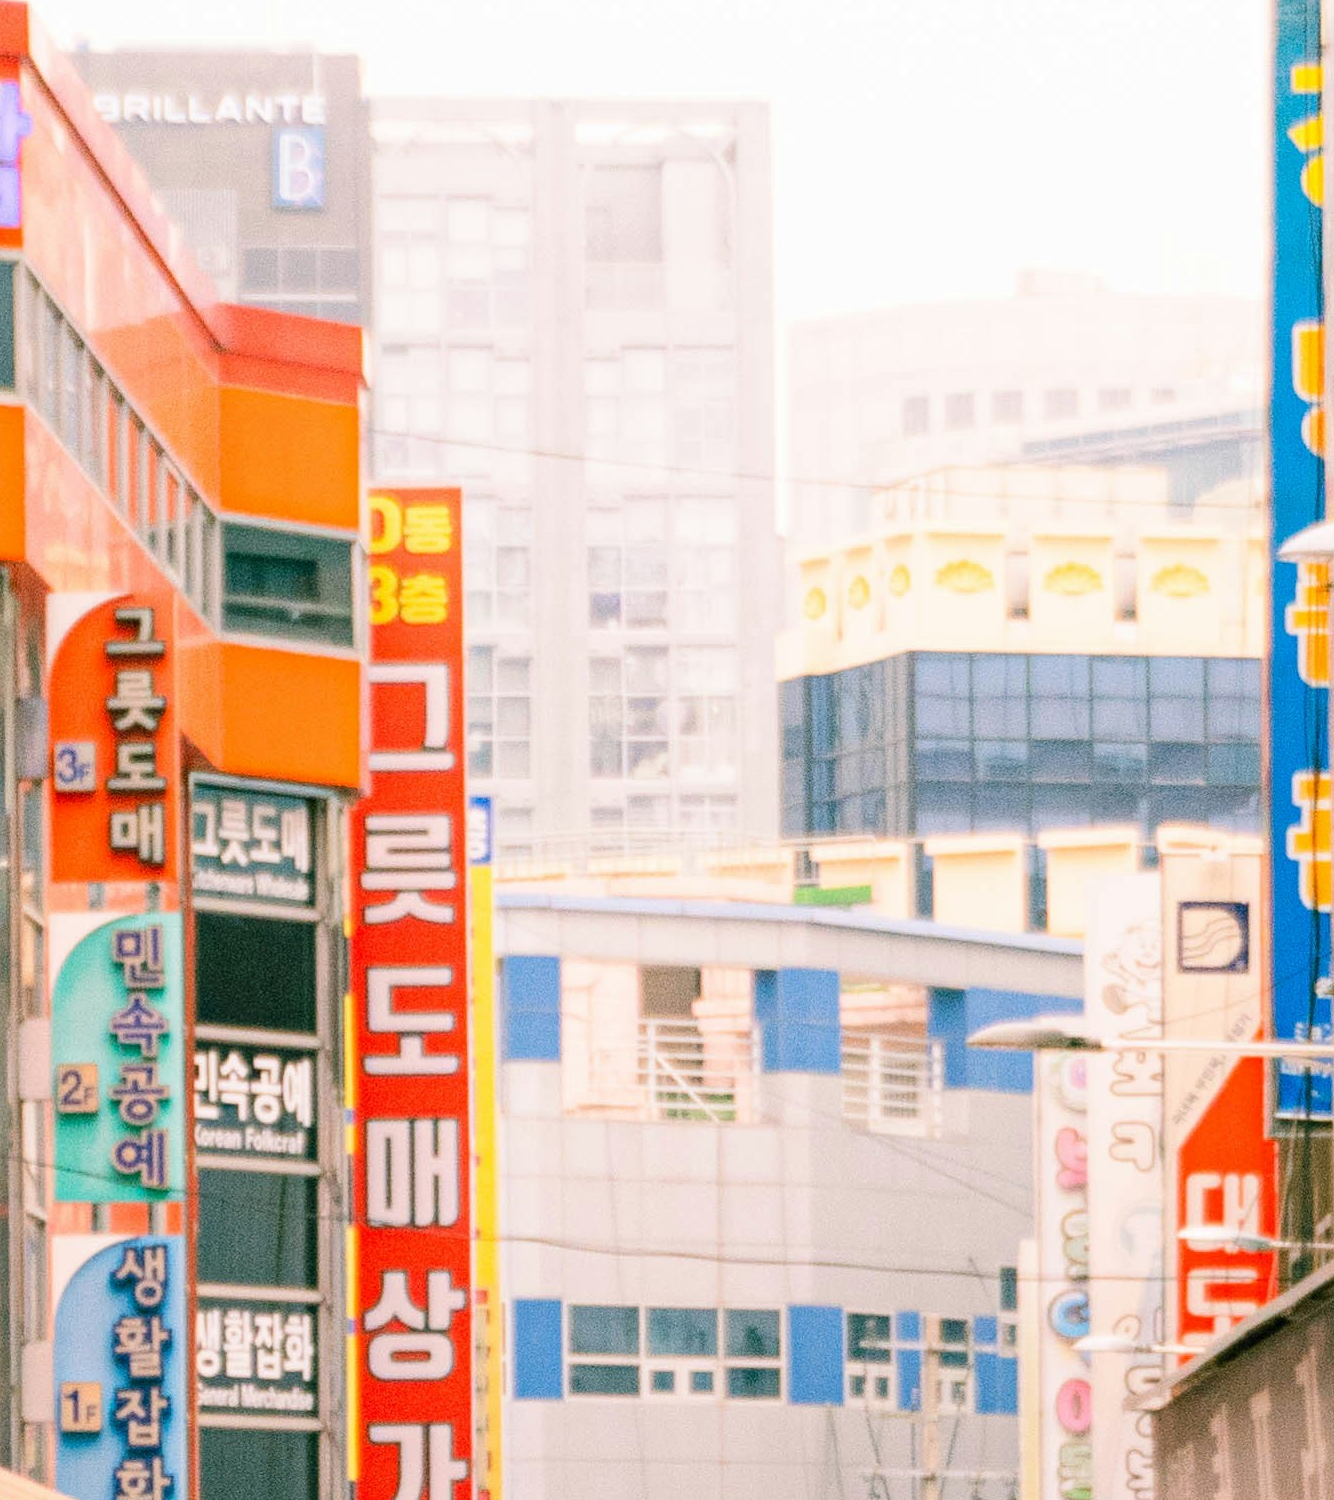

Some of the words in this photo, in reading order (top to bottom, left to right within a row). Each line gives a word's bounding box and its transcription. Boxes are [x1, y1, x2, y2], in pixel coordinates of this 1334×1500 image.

[93, 94, 327, 125] BRILLANTE
[54, 745, 91, 786] 3F
[105, 607, 168, 867] 그릇도매
[191, 798, 310, 875] 그릇도매
[60, 1071, 96, 1108] 2F
[109, 925, 170, 1190] 민속공예
[193, 1049, 313, 1128] 민속공예
[196, 1308, 314, 1382] 생활잡화
[63, 1390, 99, 1429] 1F
